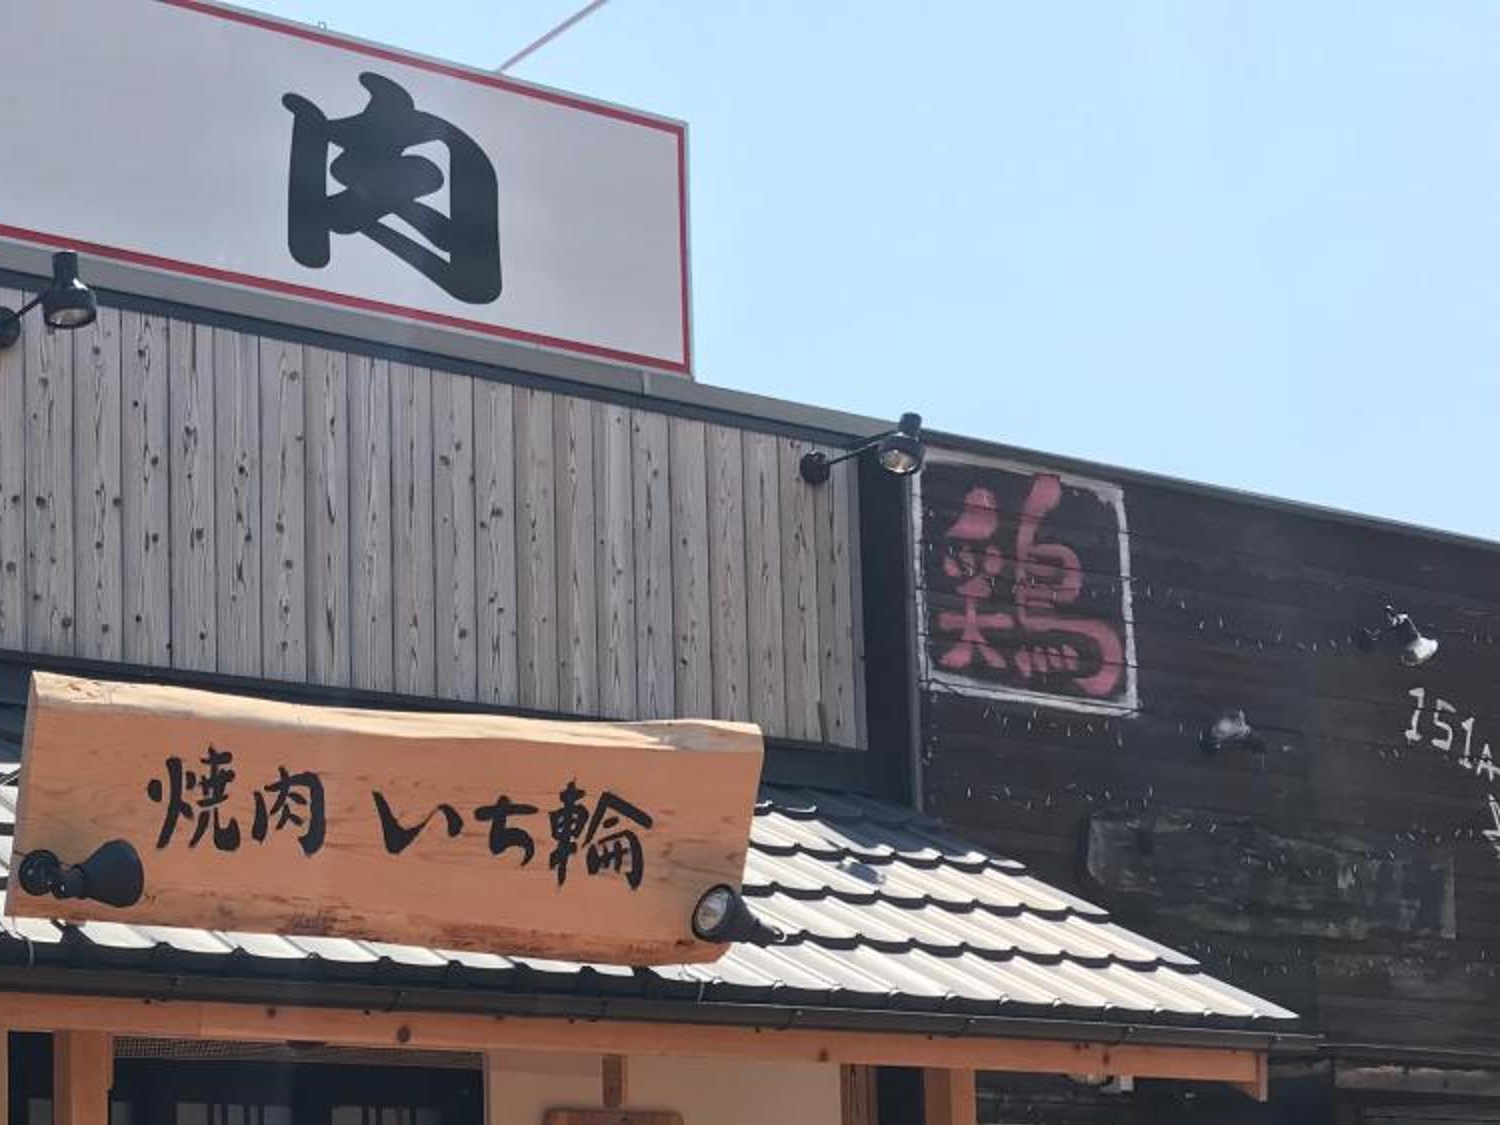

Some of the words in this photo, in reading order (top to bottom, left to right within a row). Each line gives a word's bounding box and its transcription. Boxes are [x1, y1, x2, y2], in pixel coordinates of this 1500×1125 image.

[146, 745, 327, 857] 焼肉
[371, 779, 655, 891] いち輪
